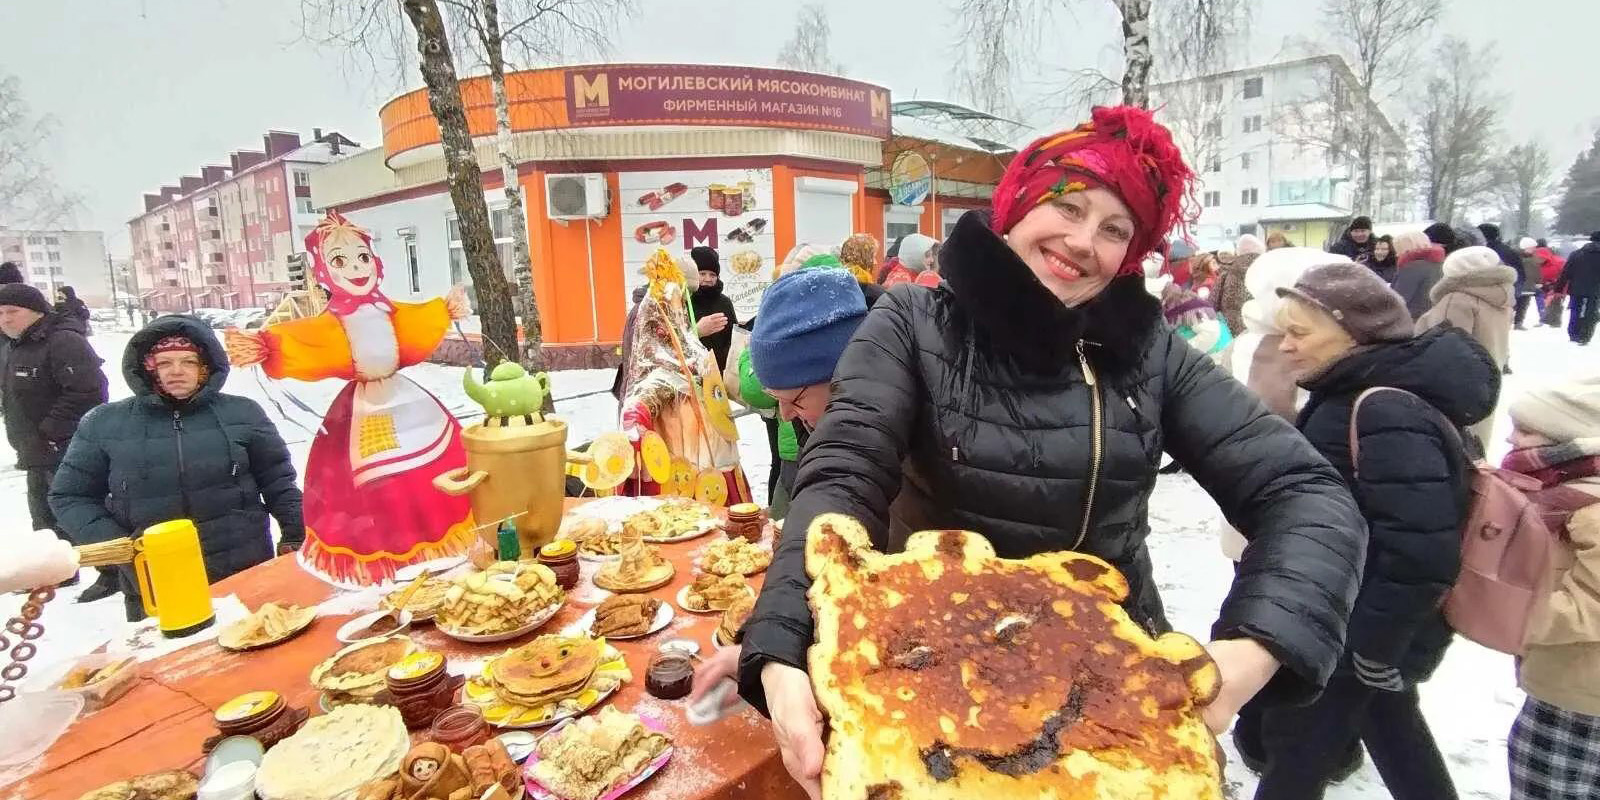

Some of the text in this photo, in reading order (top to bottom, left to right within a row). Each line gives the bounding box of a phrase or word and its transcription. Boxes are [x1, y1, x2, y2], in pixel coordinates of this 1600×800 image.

[573, 73, 609, 108] М
[618, 74, 866, 102] МОГИЛЕВСКИЙ МЯСОКОМБИНАТ
[663, 98, 842, 118] ФИРМЕННЫЙ МАГАЗИН №16
[870, 89, 887, 120] М
[682, 217, 719, 250] М
